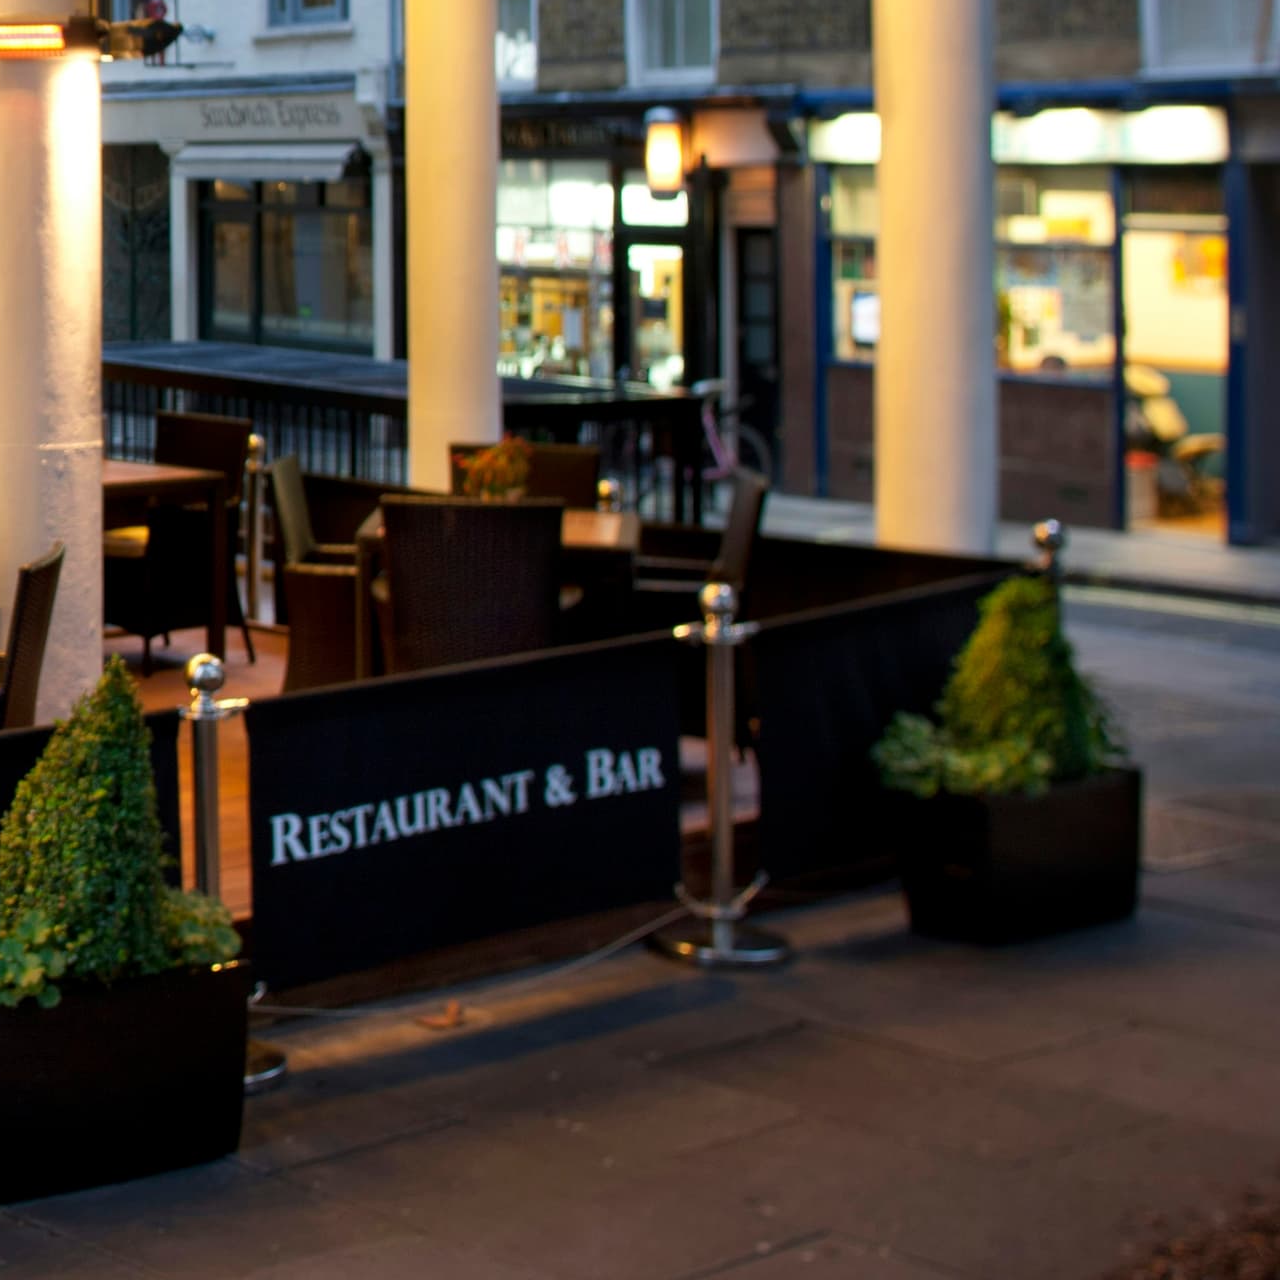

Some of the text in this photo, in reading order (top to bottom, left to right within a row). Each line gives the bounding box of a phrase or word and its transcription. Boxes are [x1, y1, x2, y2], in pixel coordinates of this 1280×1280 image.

[269, 747, 666, 867] RESTAURANT & BAR
